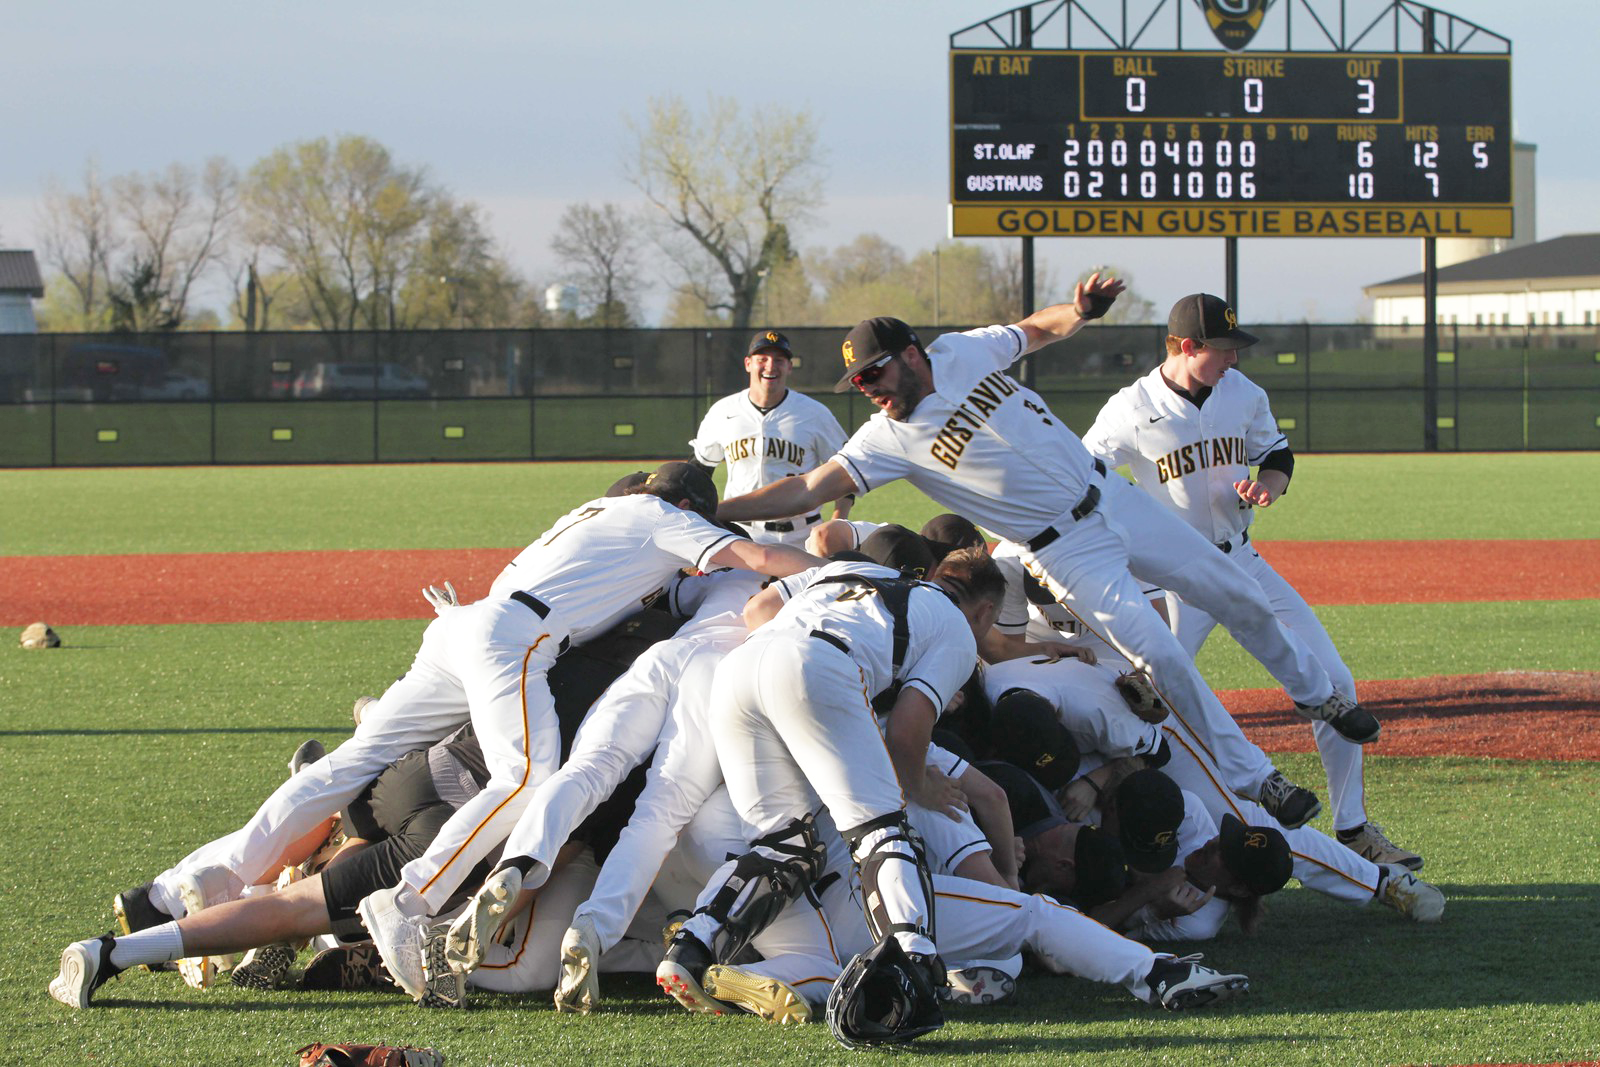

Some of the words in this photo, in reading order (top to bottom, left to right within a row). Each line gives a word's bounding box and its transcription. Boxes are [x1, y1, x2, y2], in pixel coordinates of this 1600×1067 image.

[973, 57, 994, 75] AT
[999, 57, 1032, 76] BAT
[1113, 58, 1157, 76] BALL
[1223, 59, 1285, 77] STRIKE
[1346, 60, 1382, 78] OUT
[1126, 77, 1146, 112] 0
[1243, 78, 1263, 113] 0
[1356, 79, 1375, 114] 3
[1066, 124, 1075, 139] 1
[1090, 124, 1100, 140] 2
[1115, 124, 1125, 140] 3
[1142, 124, 1153, 140] 4
[1166, 124, 1176, 140] 5
[1190, 124, 1201, 140] 6
[1219, 125, 1229, 140] 7
[1243, 125, 1253, 140] 8
[1266, 125, 1276, 140] 9
[1290, 125, 1309, 141] 10
[1337, 126, 1377, 141] RUNS
[1405, 126, 1439, 142] HITS
[1466, 126, 1495, 142] ERR
[1357, 141, 1373, 167] 6
[1414, 142, 1439, 168] 12
[1473, 142, 1488, 168] 5
[967, 175, 1043, 191] GUSTAVUS
[1349, 173, 1374, 199] 10
[1425, 173, 1439, 197] 7
[997, 210, 1144, 232] GOLDEN
[1157, 210, 1281, 232] GUSTIE
[1294, 211, 1472, 233] BASEBALL
[725, 436, 805, 467] GUSTAVUS
[543, 507, 606, 547] 7
